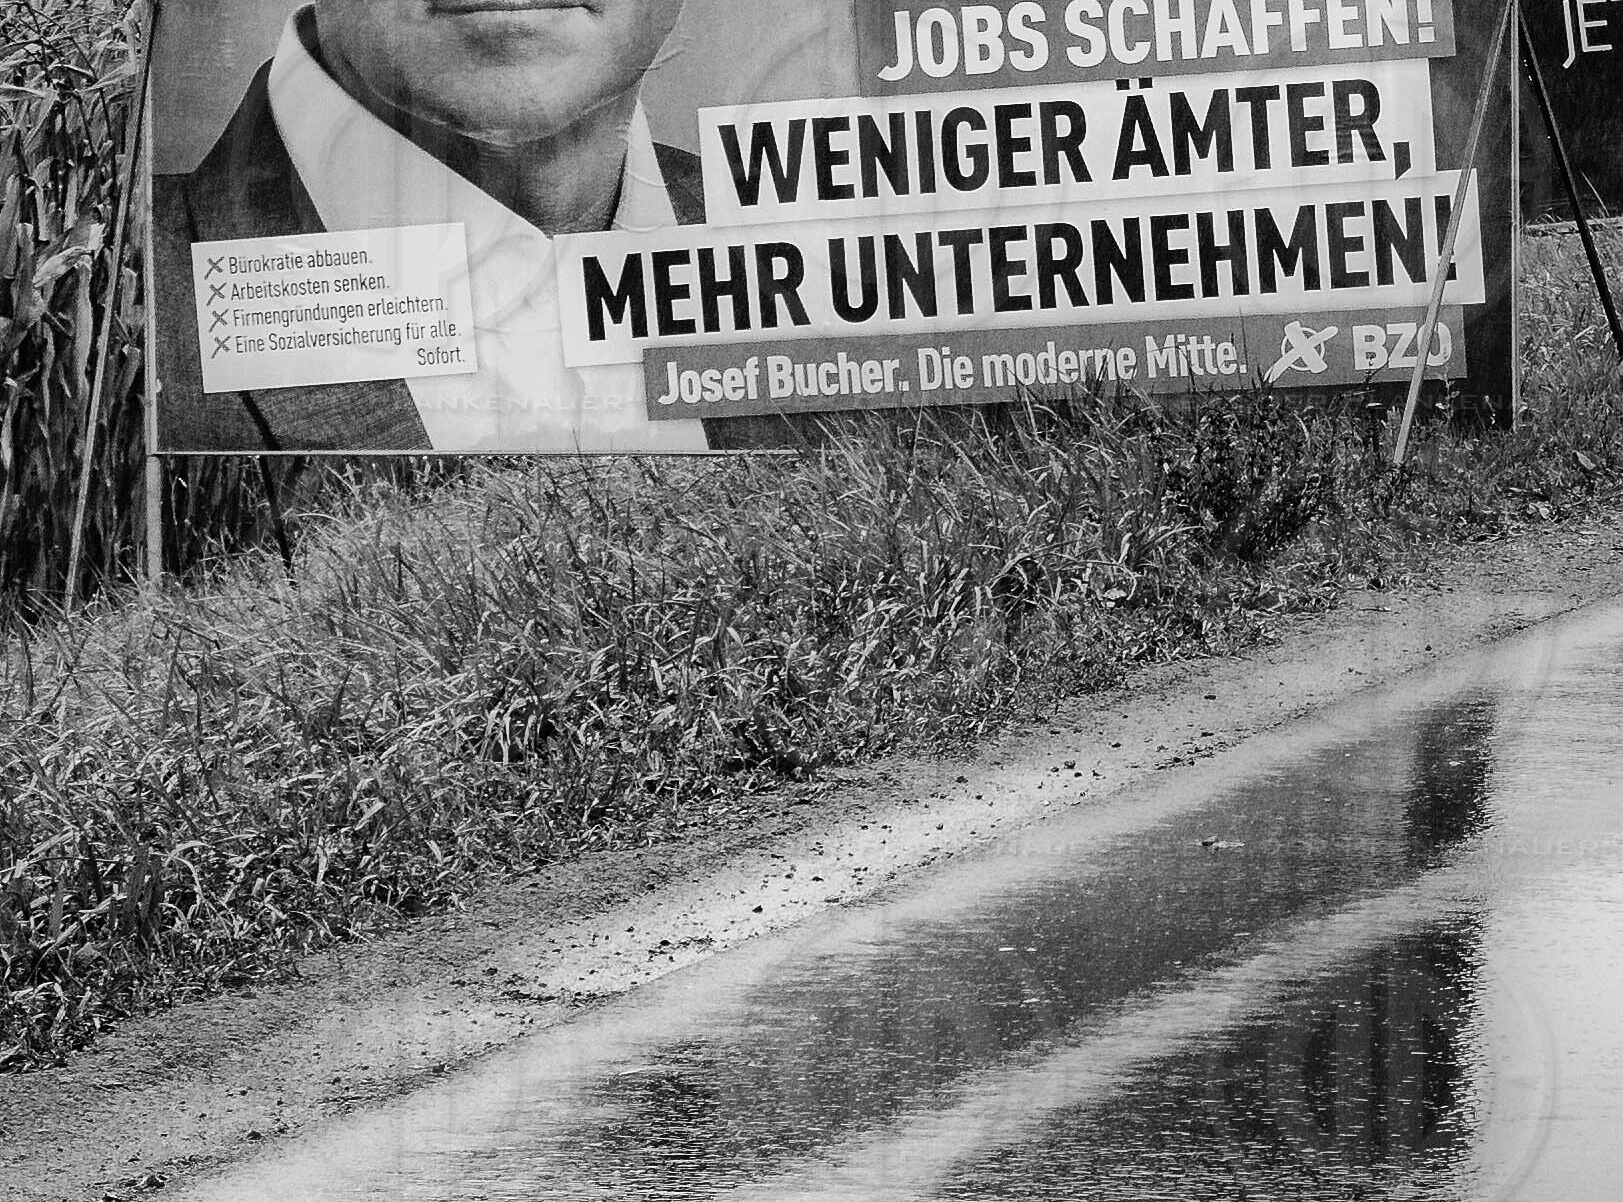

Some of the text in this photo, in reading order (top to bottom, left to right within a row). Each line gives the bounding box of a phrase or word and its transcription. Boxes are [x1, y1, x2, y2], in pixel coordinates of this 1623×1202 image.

[718, 78, 1413, 206] WENIGER ÄMTER,
[229, 248, 374, 275] Bürokratie abbauen.
[583, 195, 1458, 342] MEHR UNTERNEHMEN!
[230, 273, 391, 301] Arbeitskosten senken.
[233, 295, 449, 328] Firmengründungen erleichtern.
[235, 335, 265, 354] Eine
[268, 324, 401, 352] Sozialversicherung
[406, 322, 426, 340] für
[416, 346, 466, 366] Sofort.
[658, 330, 1248, 406] Josef Bucher. Die moderne Mitte.
